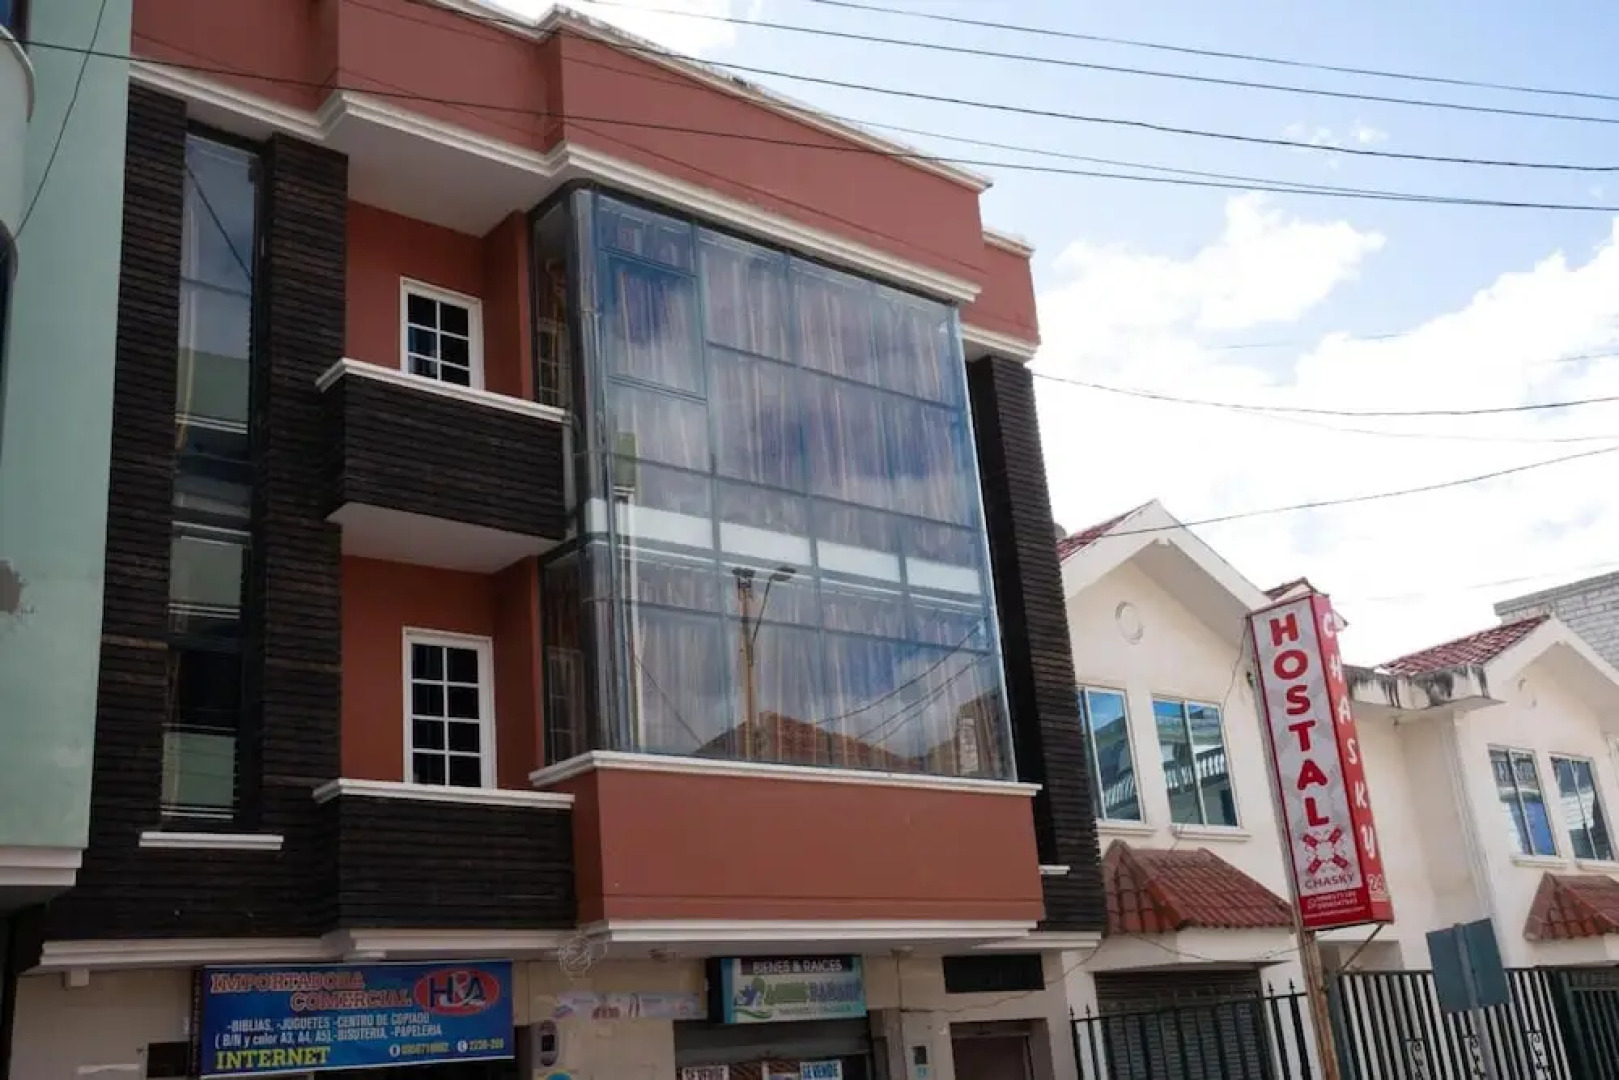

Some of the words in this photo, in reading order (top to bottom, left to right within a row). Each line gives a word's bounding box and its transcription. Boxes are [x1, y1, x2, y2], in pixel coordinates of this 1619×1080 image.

[1268, 612, 1331, 828] HOSTAL
[1323, 611, 1376, 859] CHASKY
[1304, 872, 1354, 889] CHASKY
[752, 960, 790, 974] BIENES
[210, 971, 365, 994] IMPORTADORA
[290, 989, 413, 1012] COMERCIAL
[375, 1013, 388, 1026] DE
[390, 1012, 430, 1025] COPIADO
[252, 1032, 278, 1045] color
[215, 1046, 331, 1070] INTERNET
